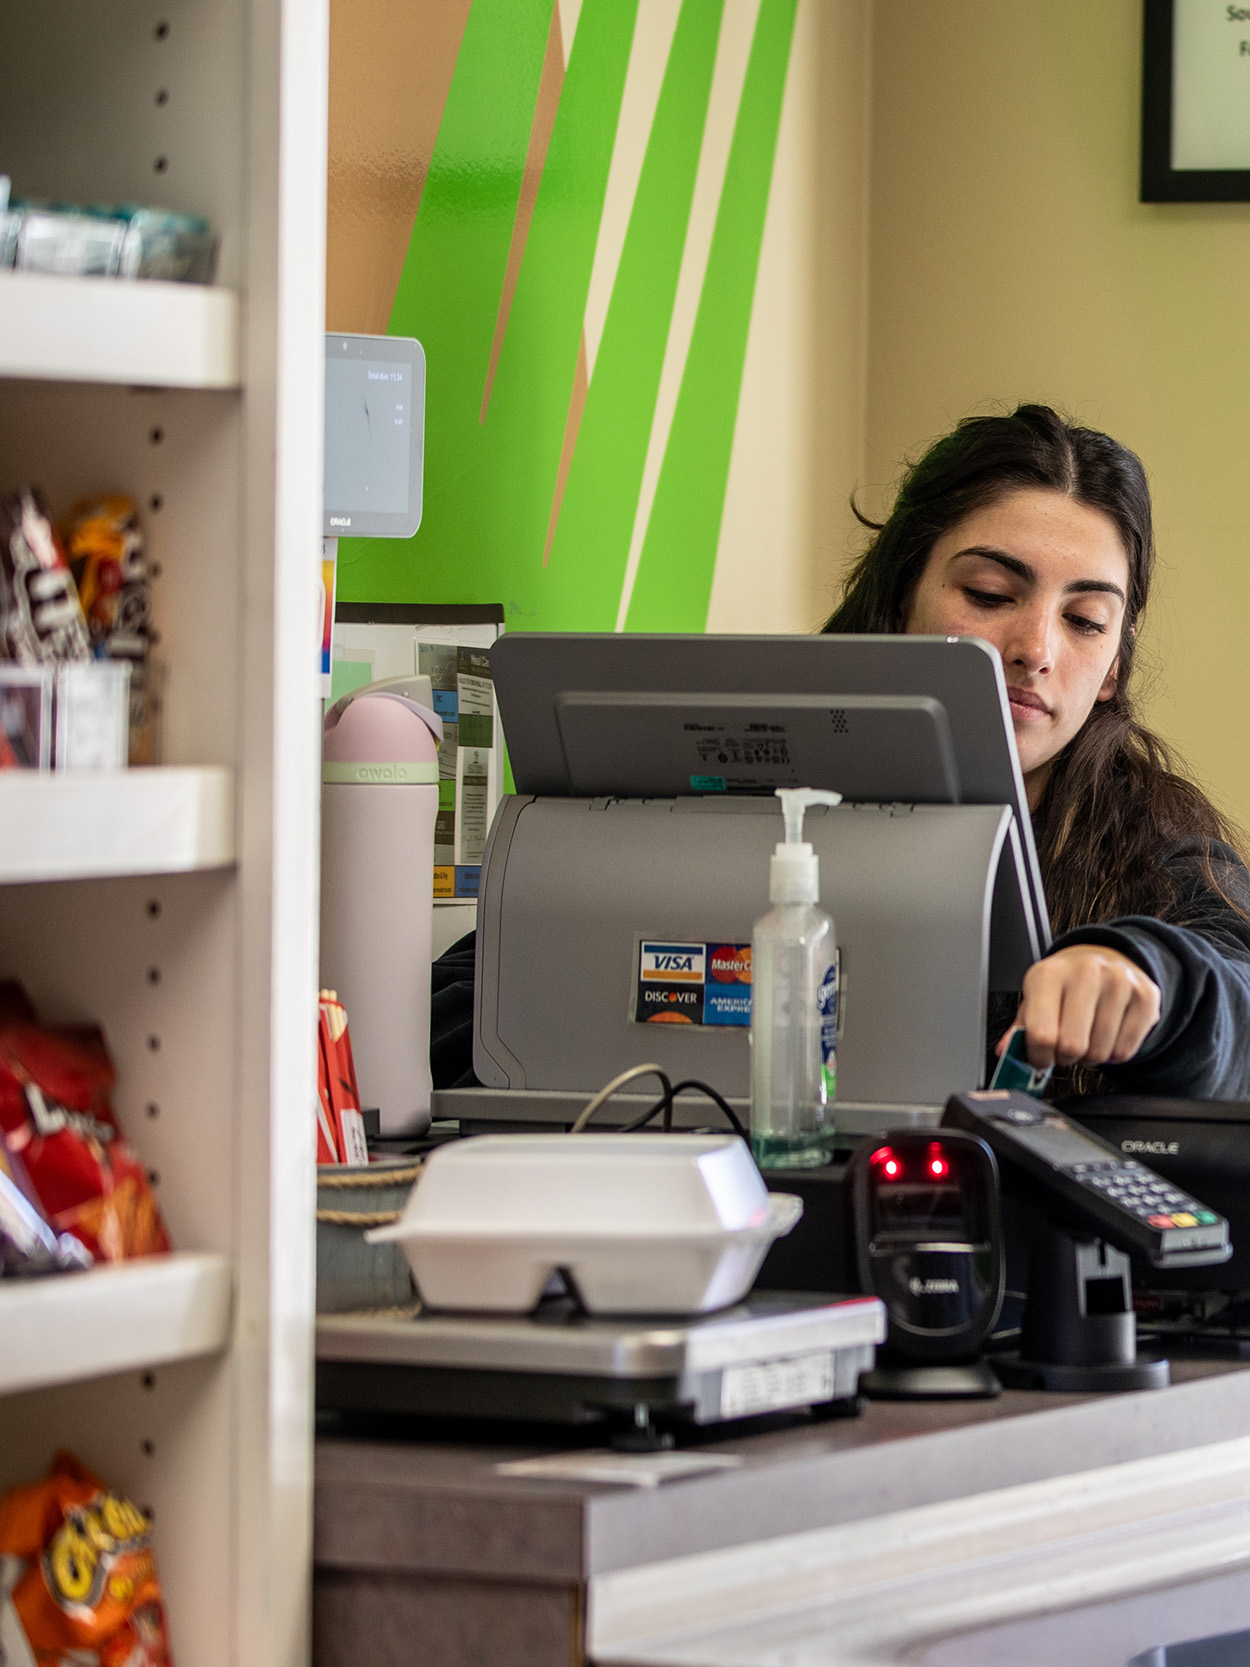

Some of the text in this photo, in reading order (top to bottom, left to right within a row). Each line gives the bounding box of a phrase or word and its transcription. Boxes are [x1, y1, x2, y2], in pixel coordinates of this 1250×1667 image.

[653, 954, 693, 971] VISA
[644, 990, 697, 1004] DISCOVER
[1120, 1139, 1180, 1156] ORACLE
